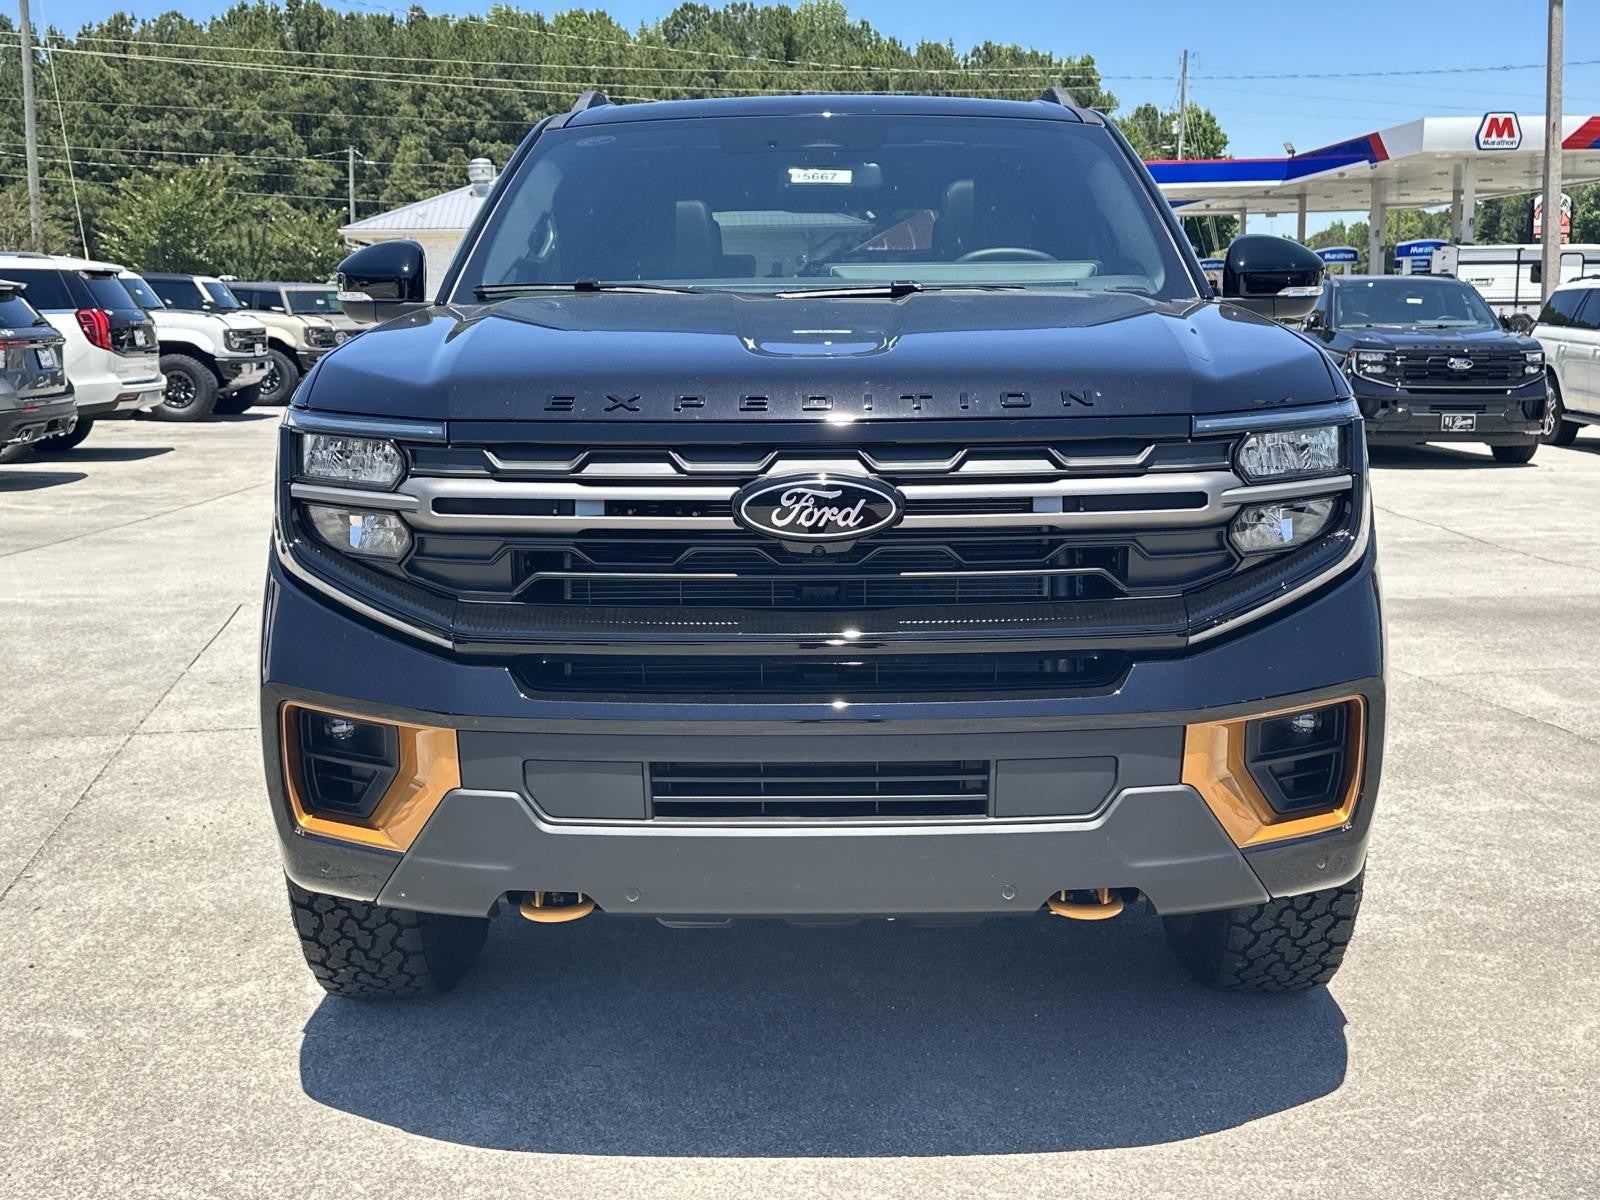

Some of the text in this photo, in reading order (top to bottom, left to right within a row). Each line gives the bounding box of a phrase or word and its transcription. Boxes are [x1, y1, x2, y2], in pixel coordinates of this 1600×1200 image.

[1484, 117, 1515, 138] M
[1324, 252, 1355, 260] Marathon
[543, 390, 1096, 411] EXPEDITION
[771, 487, 867, 527] Ford
